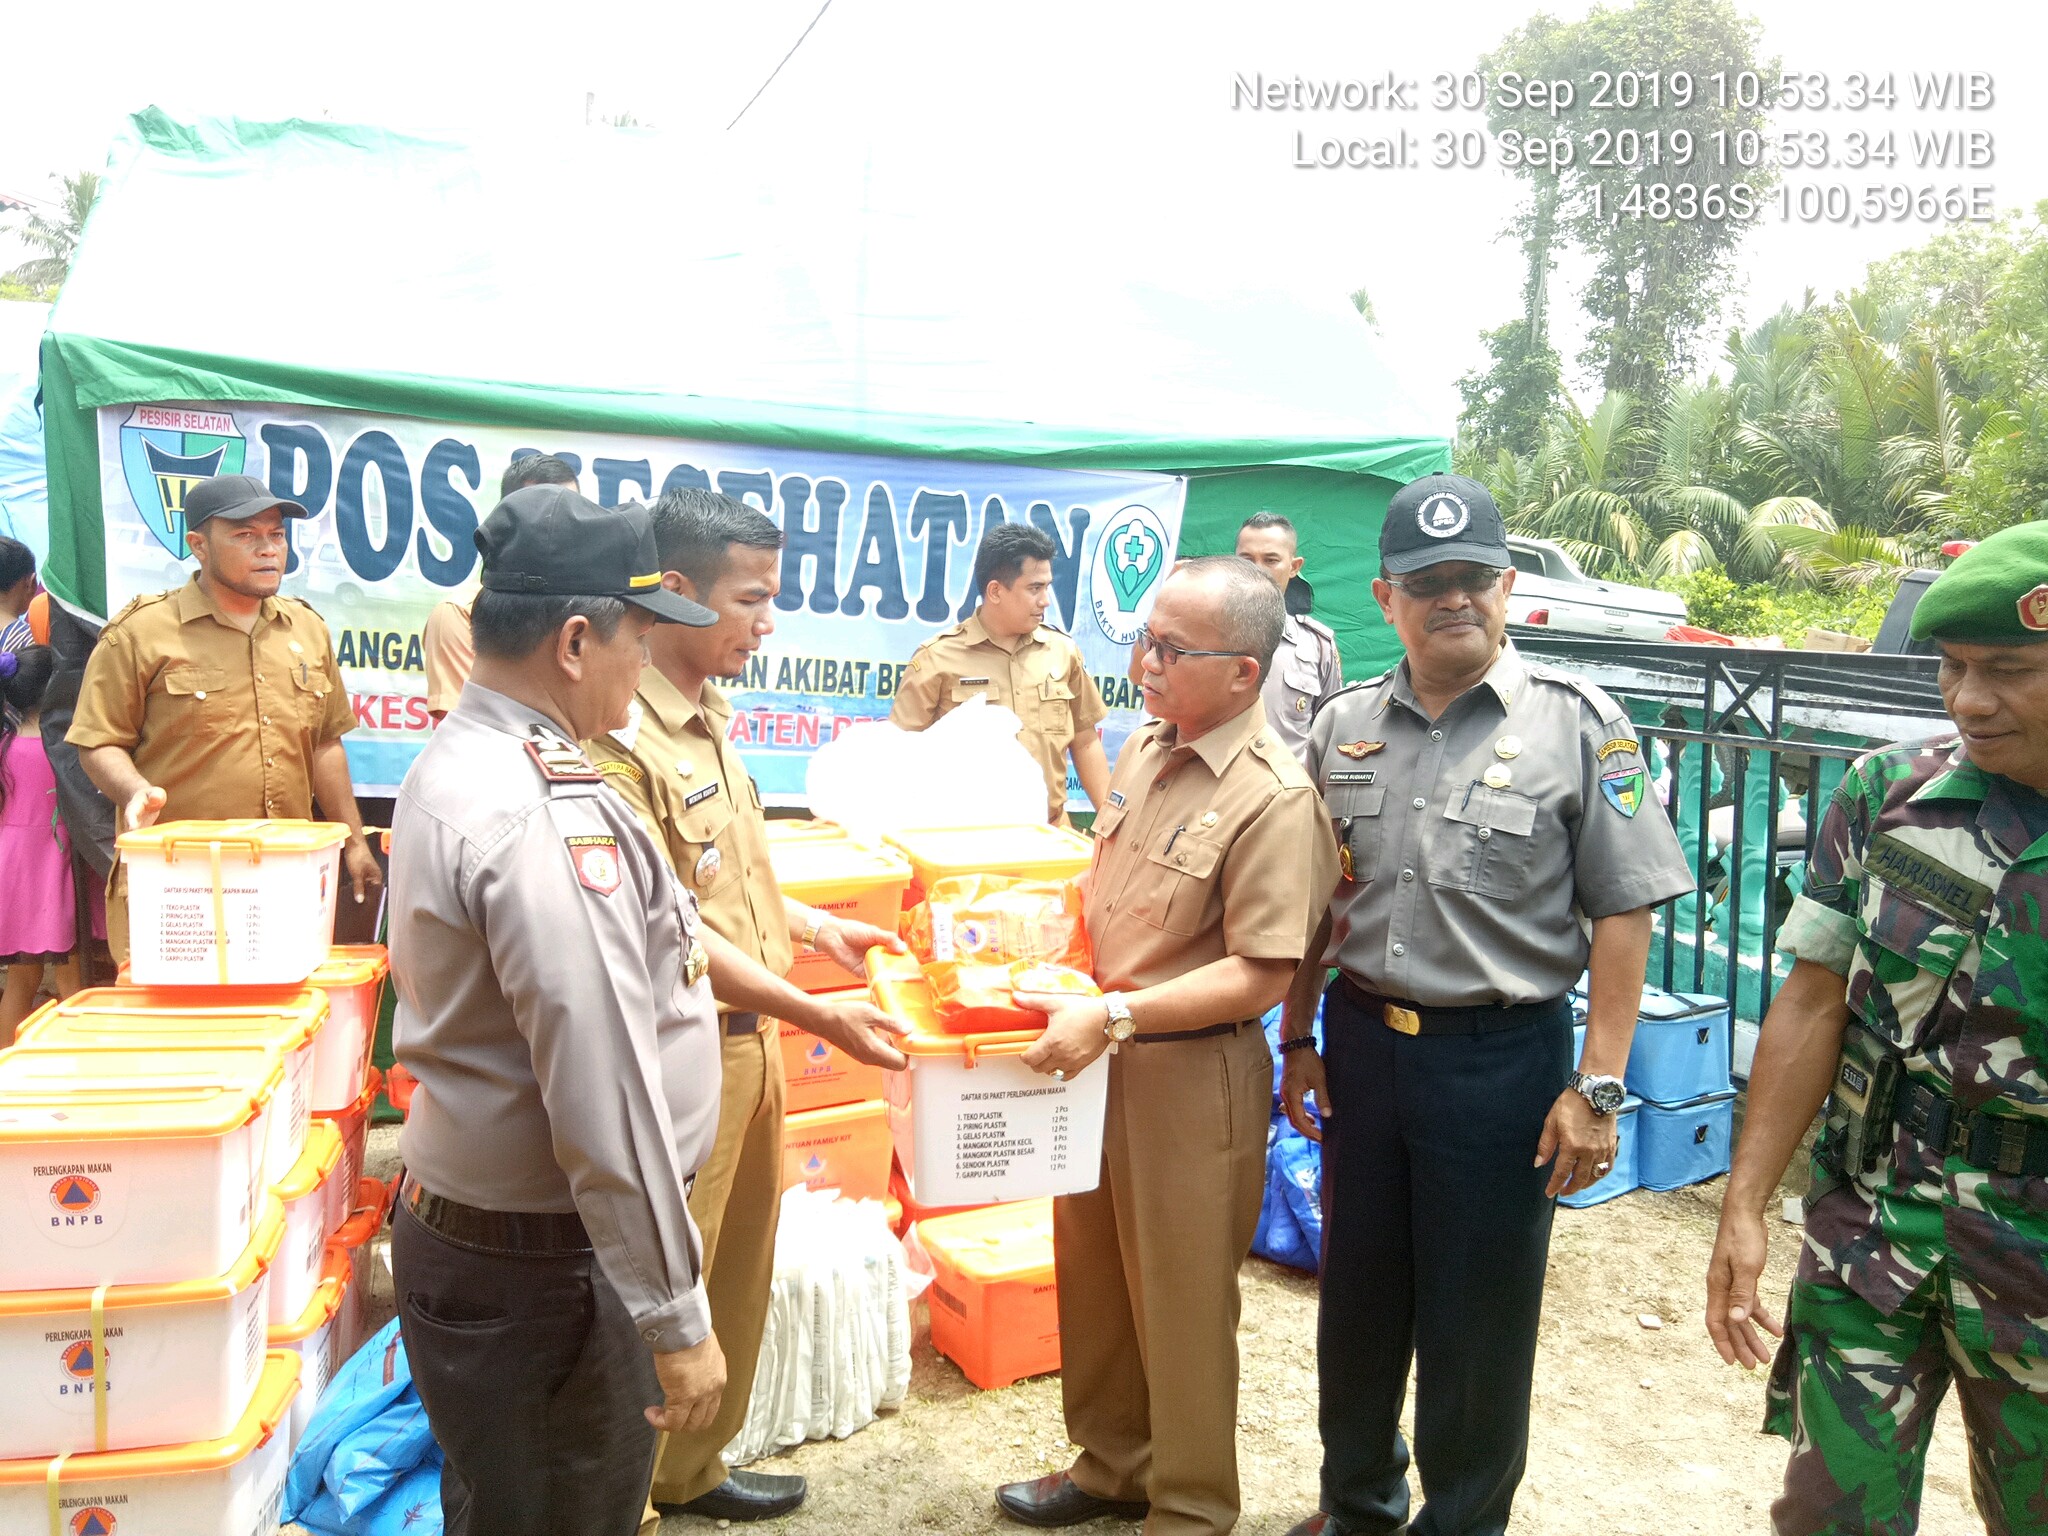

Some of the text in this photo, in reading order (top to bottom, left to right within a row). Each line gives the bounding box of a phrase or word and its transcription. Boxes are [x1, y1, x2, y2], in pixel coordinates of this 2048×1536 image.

[140, 409, 231, 432] PESISIR SELATAN
[260, 422, 481, 587] POS
[1095, 600, 1116, 638] BAKTI
[775, 656, 870, 696] AKIBAT
[846, 901, 858, 909] KIT
[961, 1093, 981, 1101] DAFTAR
[990, 1091, 1006, 1099] PAKET
[1006, 1088, 1047, 1099] PERLENGKAPAN
[1047, 1086, 1066, 1095] MAKAN
[963, 1112, 978, 1121] TEKO
[979, 1111, 1003, 1120] PLASTIK
[963, 1122, 983, 1130] PIRING
[984, 1121, 1007, 1129] PLASTIK
[963, 1132, 981, 1140] GELAS
[982, 1131, 1005, 1139] PLASTIK
[1059, 1124, 1067, 1132] Pcs
[813, 1136, 839, 1145] FAMILY
[840, 1134, 852, 1142] KIT
[963, 1141, 992, 1150] MANGKOK
[993, 1139, 1016, 1148] PLASTIK
[1017, 1138, 1032, 1146] KECIL
[963, 1151, 992, 1159] MANGKOK
[993, 1149, 1016, 1157] PLASTIK
[1017, 1147, 1035, 1155] BESAR
[1058, 1143, 1067, 1151] Pcs
[33, 1163, 112, 1177] PERLENGKAPAN MAKAN
[962, 1161, 986, 1169] SENDOK
[987, 1159, 1010, 1167] PLASTIK
[962, 1170, 982, 1179] GARPU
[983, 1169, 1006, 1177] PLASTIK
[51, 1214, 103, 1227] BNPB
[45, 1329, 92, 1342] PERLENGKAPA
[58, 1494, 129, 1509] ERLENGKAPAN MAKAN
